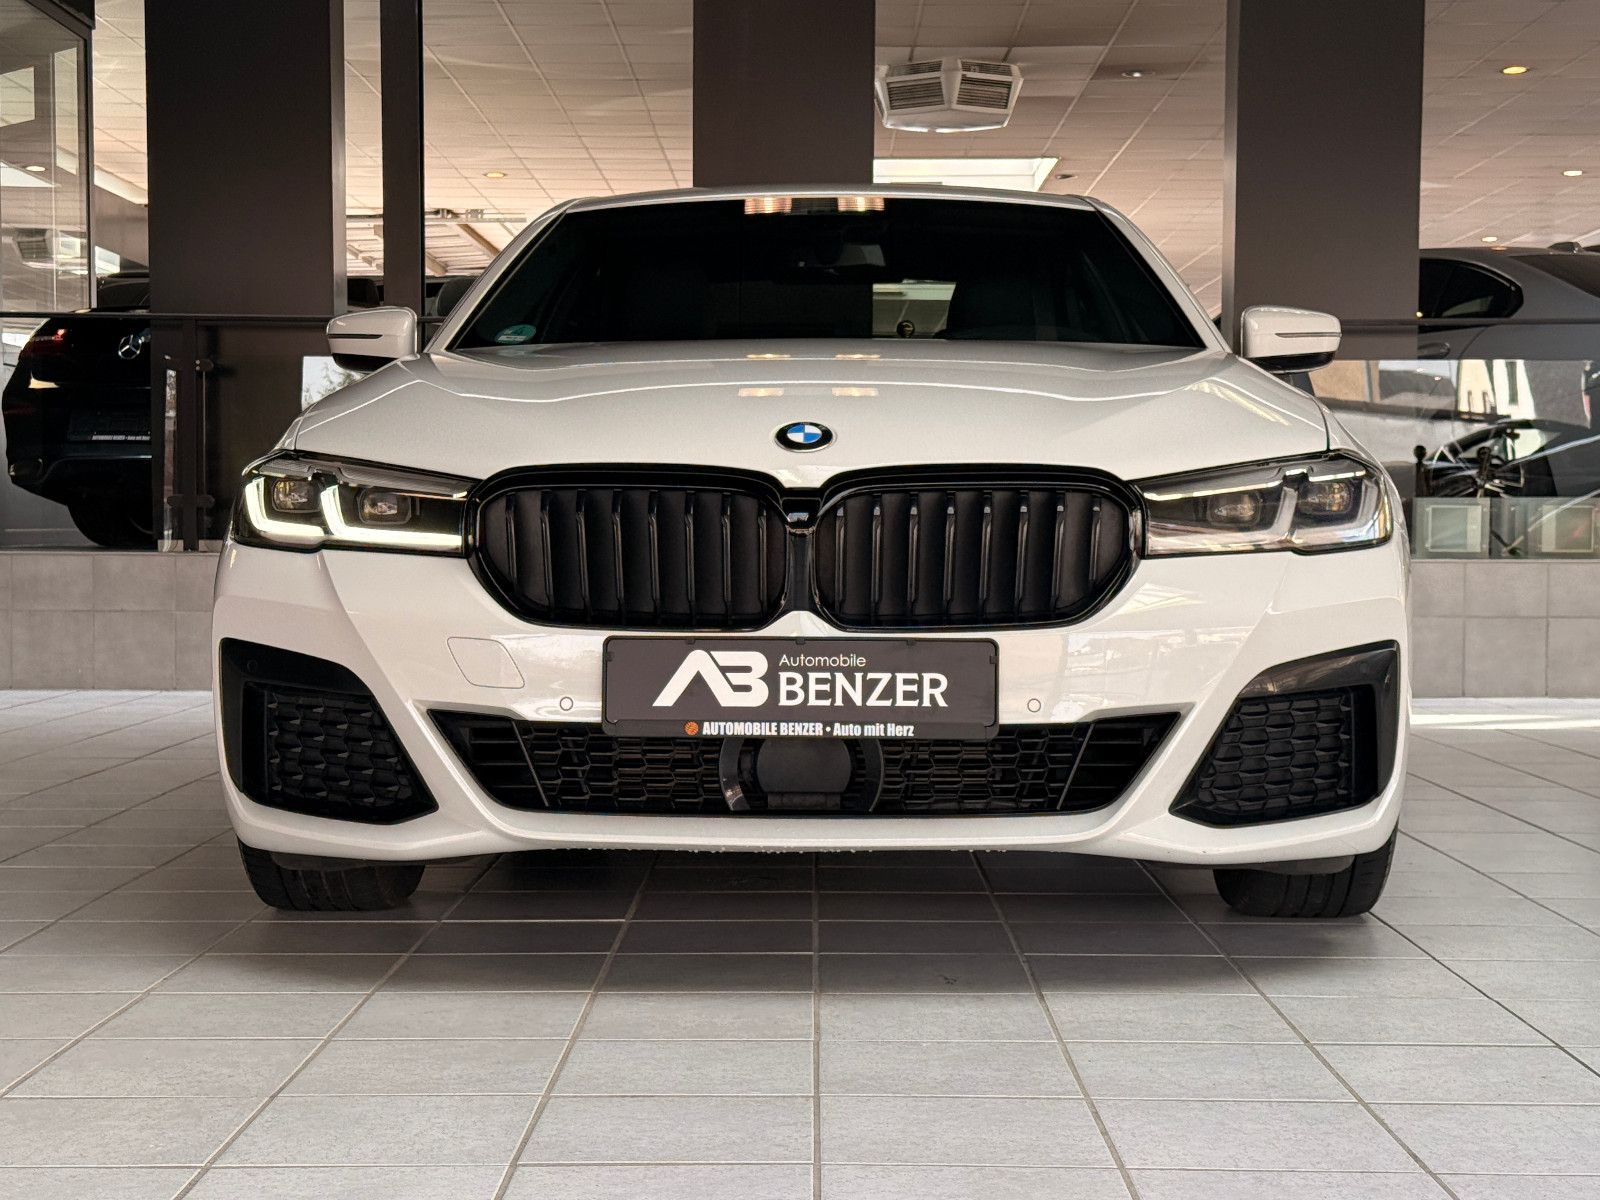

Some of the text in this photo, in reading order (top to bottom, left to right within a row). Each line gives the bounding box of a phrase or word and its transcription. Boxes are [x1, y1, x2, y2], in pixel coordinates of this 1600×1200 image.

[778, 653, 866, 667] Automobile
[777, 671, 948, 707] BENZER
[702, 721, 915, 737] AUTOMOBILE BENZER Auto mit Herz
